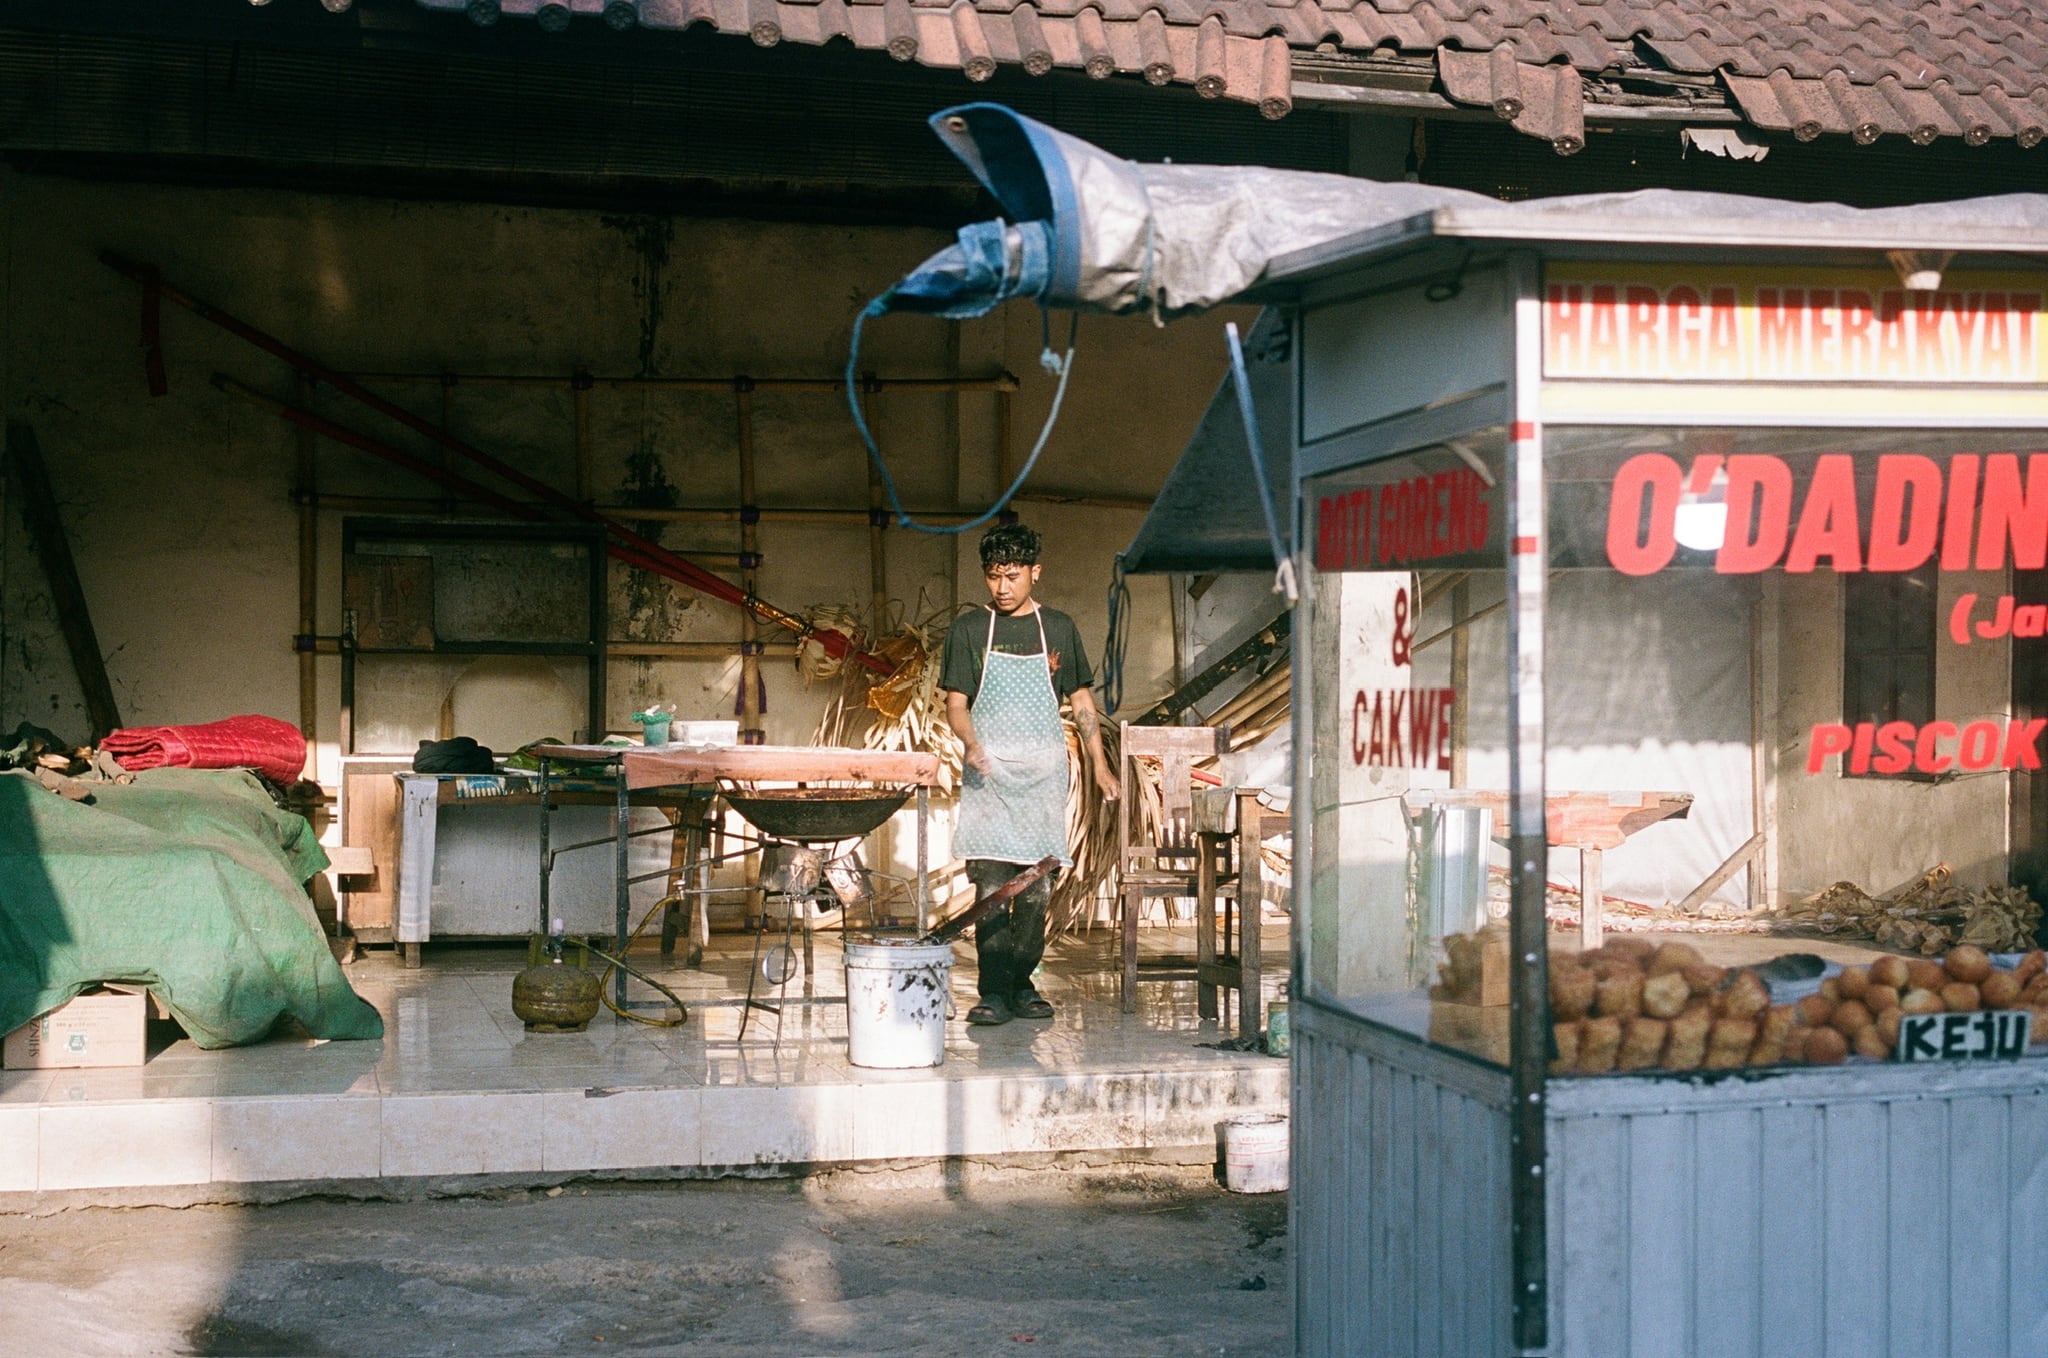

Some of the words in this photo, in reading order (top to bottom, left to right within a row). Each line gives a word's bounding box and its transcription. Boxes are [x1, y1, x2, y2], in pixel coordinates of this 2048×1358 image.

[1548, 283, 1742, 375] HARGA
[1756, 287, 2042, 379] MERAKYAT
[1317, 486, 1373, 573] ROTI
[1378, 466, 1490, 565] GORENG
[1392, 586, 1412, 667] &
[1949, 592, 2048, 645] (Ja
[1353, 687, 1456, 771] CAKWE
[1806, 718, 2048, 776] PISCOK
[28, 1019, 41, 1058] SHINZ
